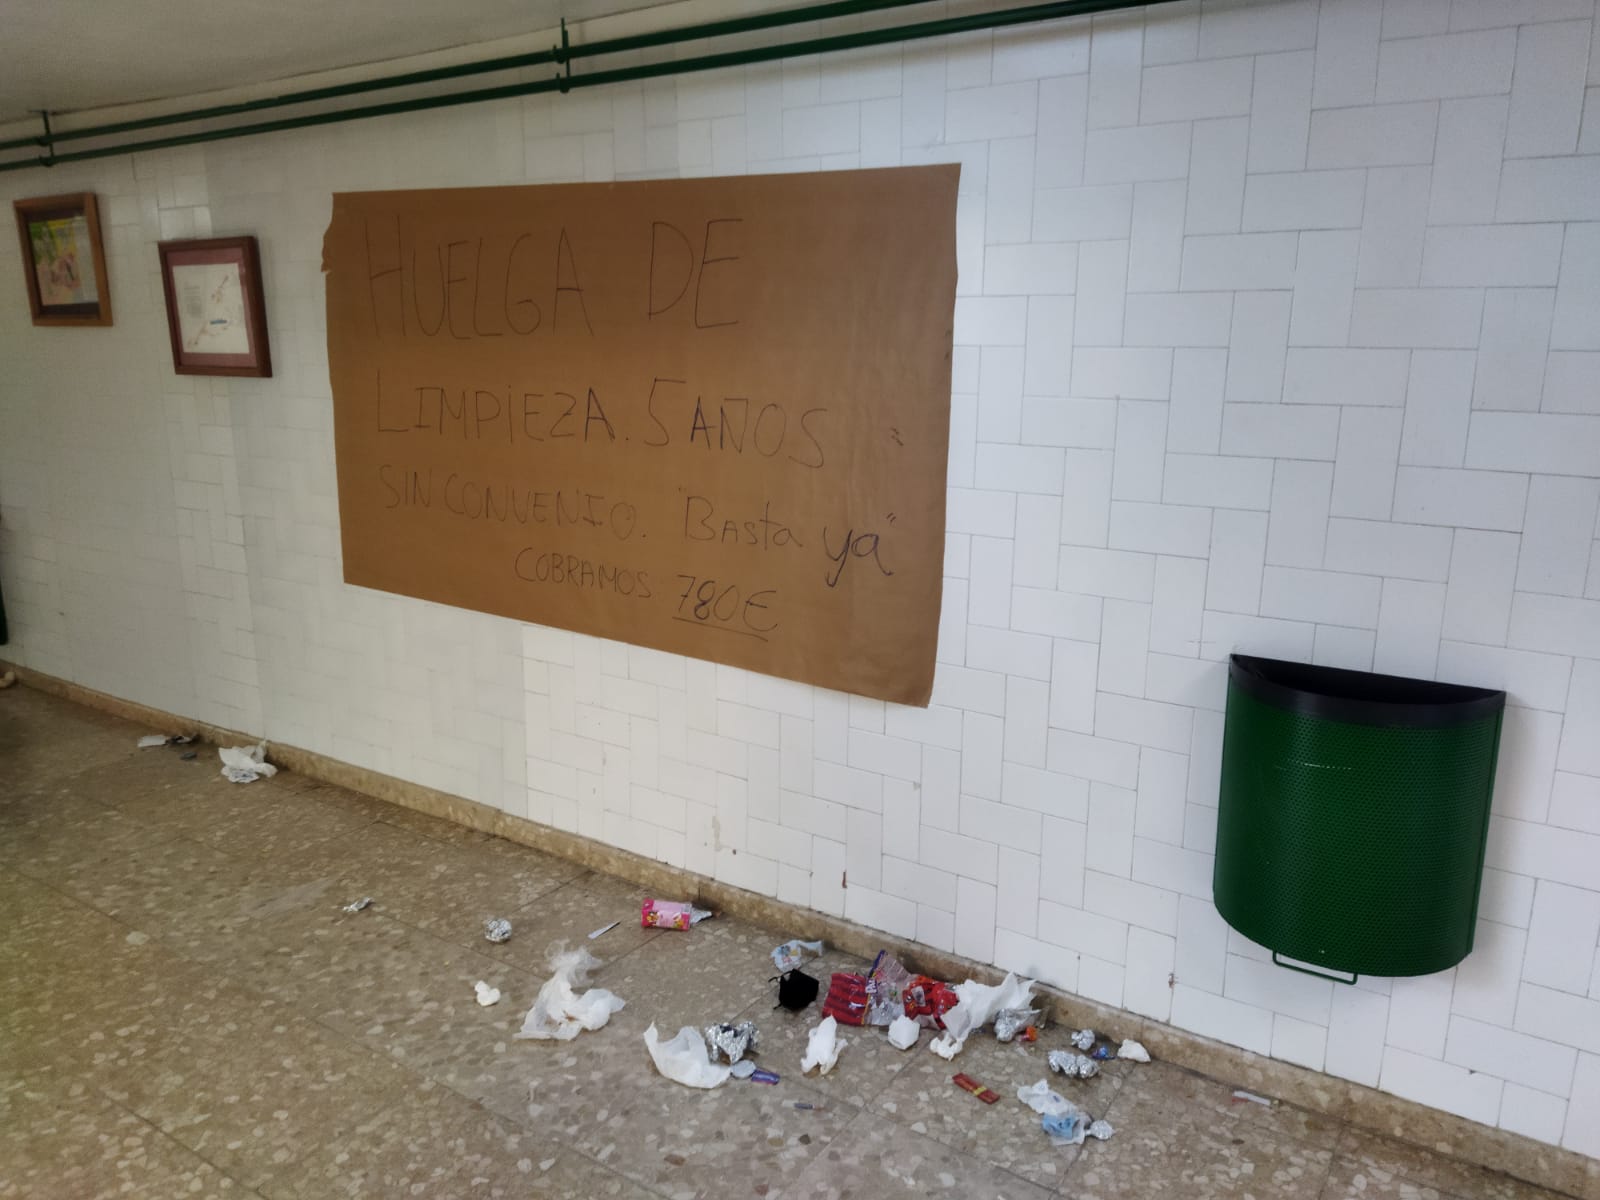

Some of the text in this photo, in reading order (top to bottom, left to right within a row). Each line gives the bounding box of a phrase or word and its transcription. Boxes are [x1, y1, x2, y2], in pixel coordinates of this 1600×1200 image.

[364, 214, 745, 340] HUELGA DE
[643, 376, 687, 447] 5
[379, 463, 433, 509] SIN
[514, 547, 652, 599] COBRAMOS
